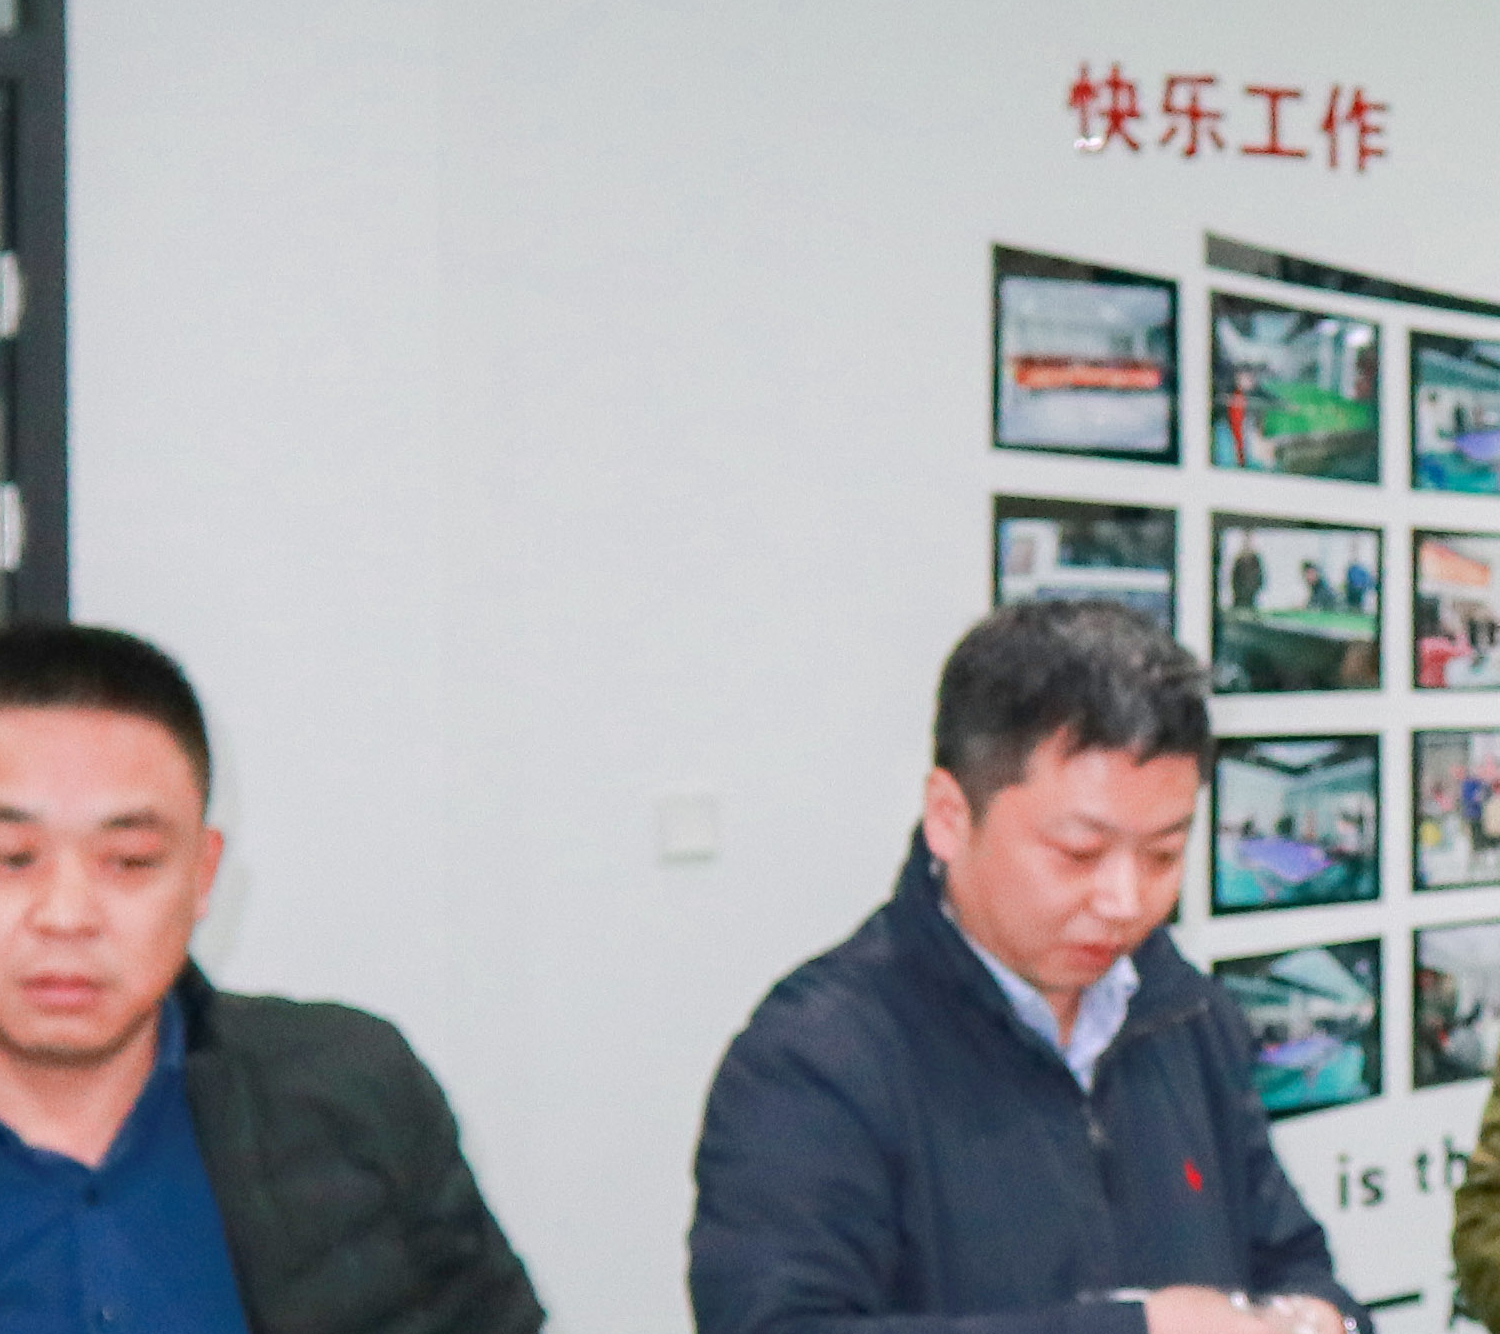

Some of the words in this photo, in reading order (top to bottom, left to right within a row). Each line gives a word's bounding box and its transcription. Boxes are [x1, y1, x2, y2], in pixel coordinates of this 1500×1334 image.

[1067, 61, 1390, 172] 快乐工作
[1338, 1152, 1385, 1210] is
